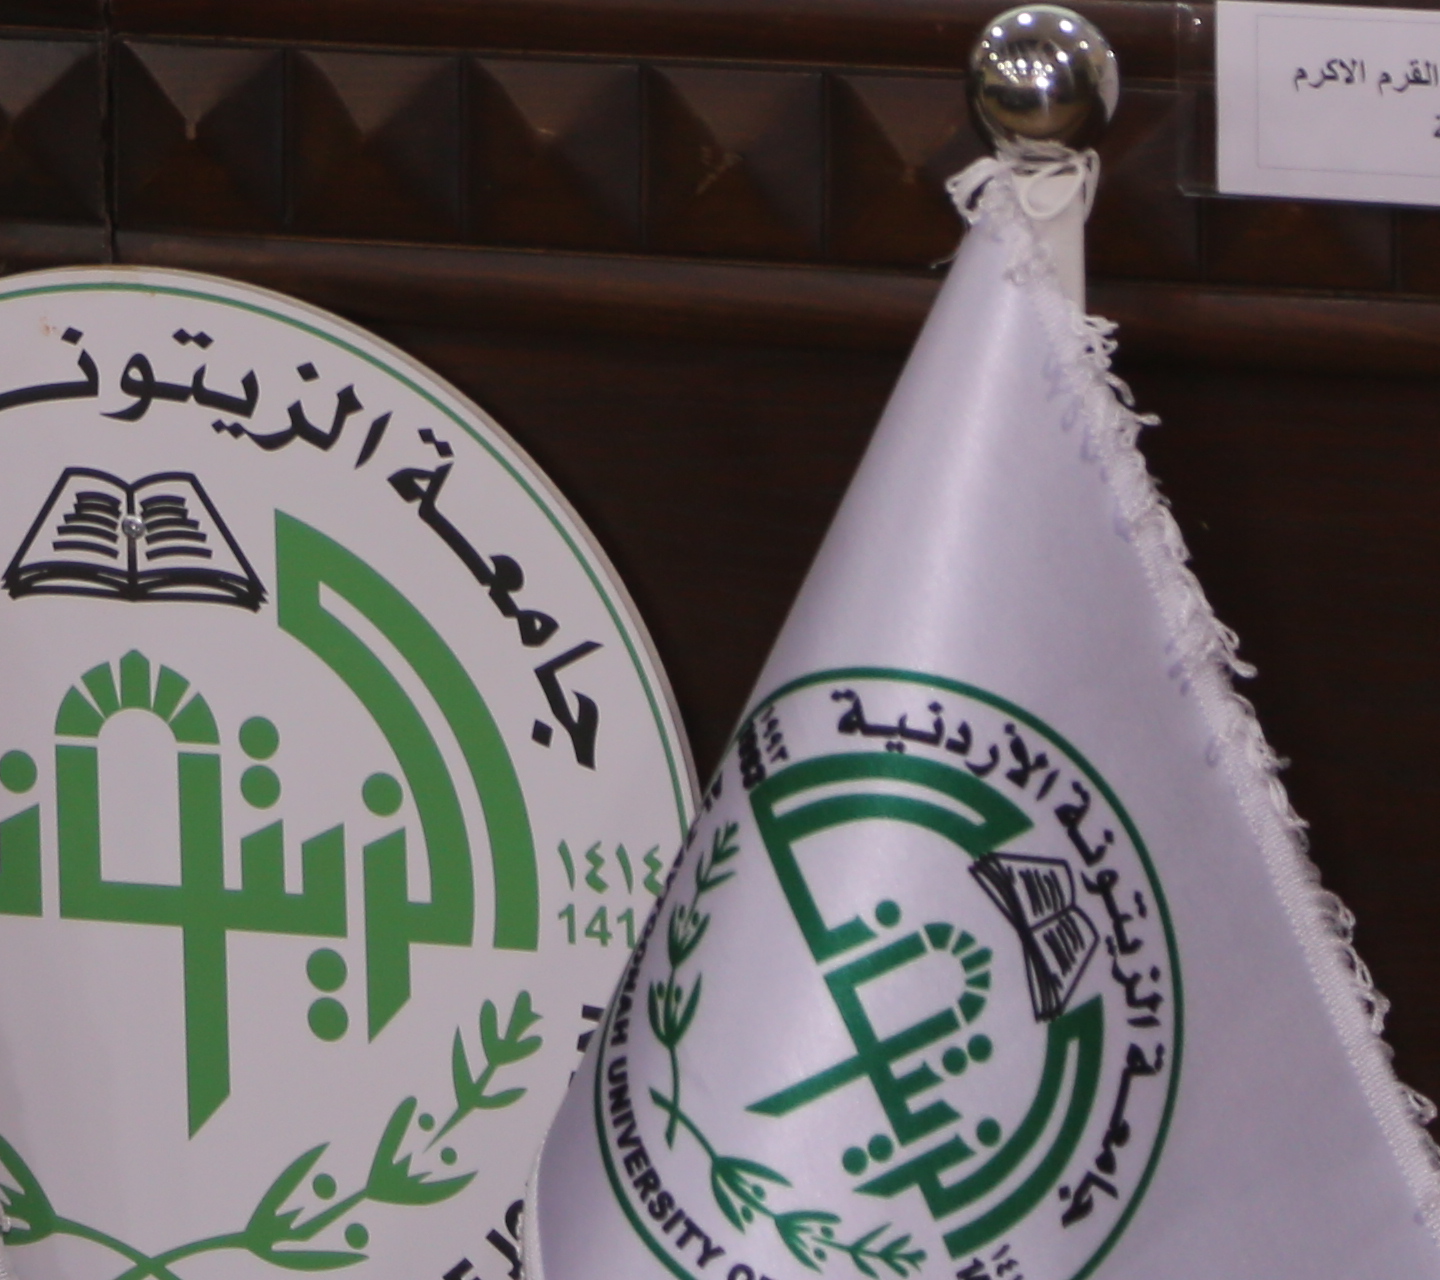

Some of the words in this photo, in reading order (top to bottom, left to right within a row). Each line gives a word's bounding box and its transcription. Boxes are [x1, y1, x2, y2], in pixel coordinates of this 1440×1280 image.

[1293, 59, 1366, 91] الاكرم
[1377, 59, 1439, 94] القرم
[556, 903, 637, 949] 141
[607, 1053, 728, 1269] UNIVERSITY
